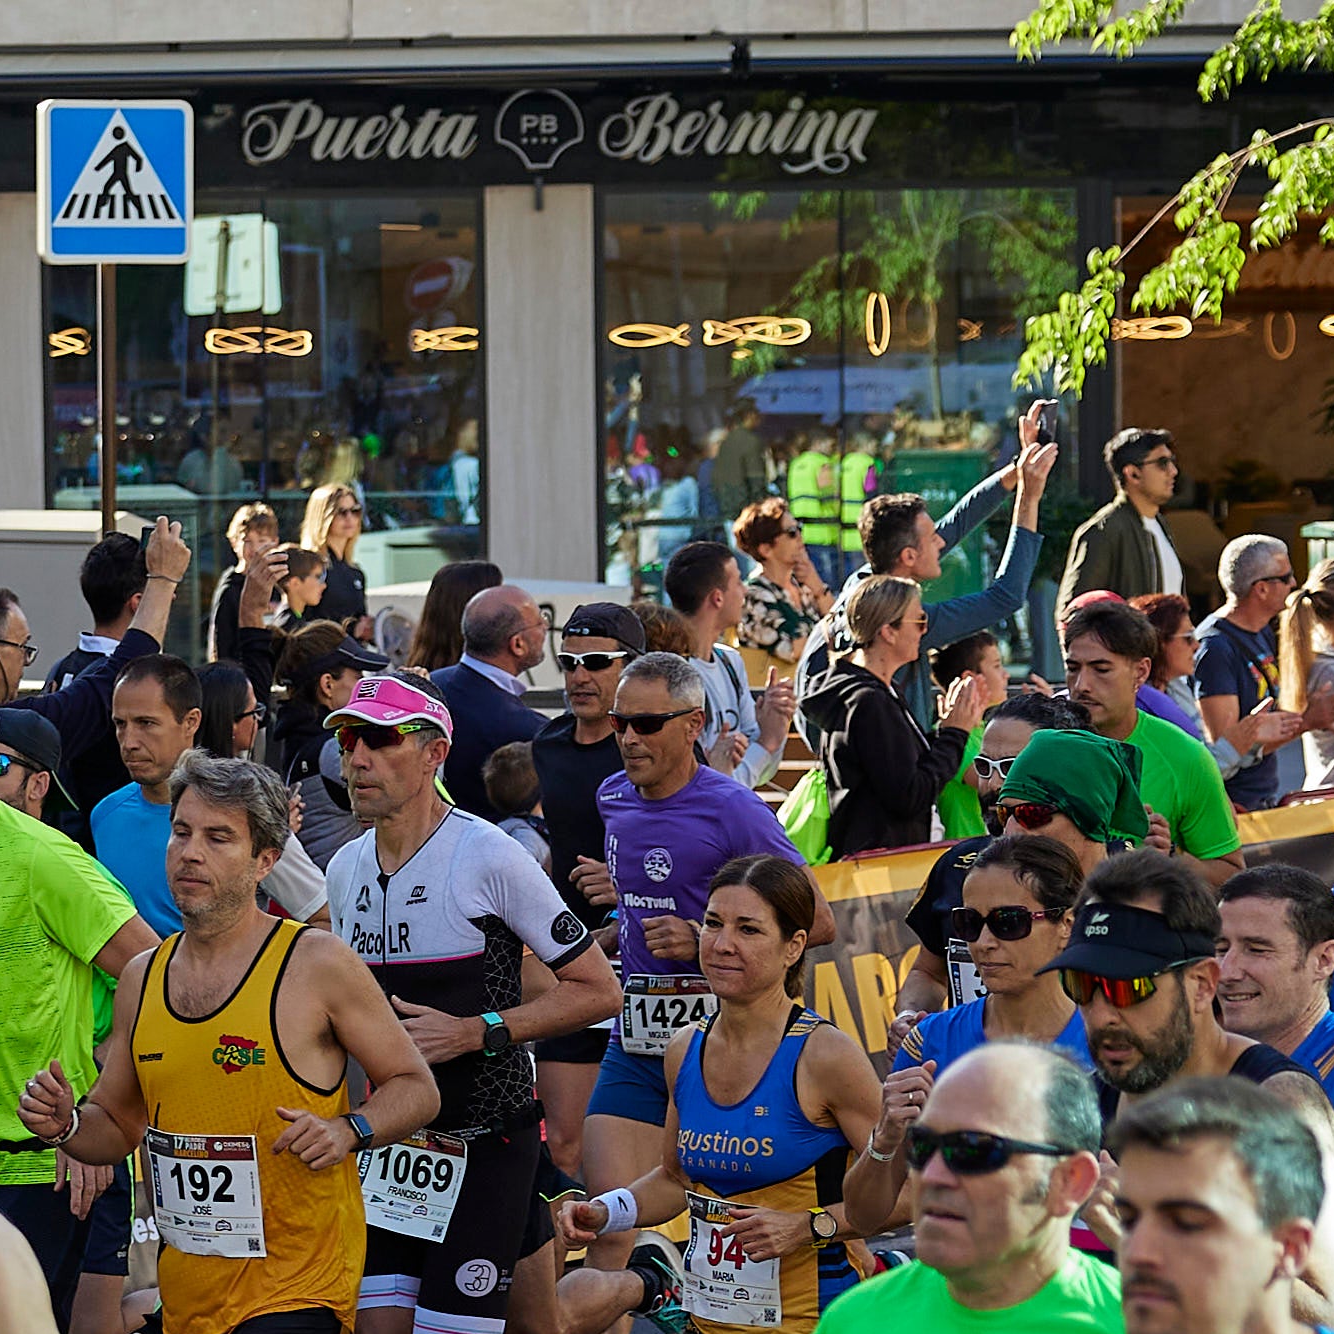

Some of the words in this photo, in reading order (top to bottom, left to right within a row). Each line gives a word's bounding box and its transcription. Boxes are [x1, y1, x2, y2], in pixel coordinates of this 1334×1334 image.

[242, 99, 478, 166] Puerta
[520, 114, 558, 134] PB
[599, 93, 878, 175] Bernina
[350, 922, 383, 956] Paco
[388, 921, 412, 954] LR
[635, 997, 706, 1029] 1424
[170, 1162, 236, 1203] 192
[378, 1146, 454, 1193] 1069
[192, 1203, 213, 1216] JOSÉ
[386, 1185, 428, 1202] FRANCISCO
[706, 1227, 747, 1271] 94
